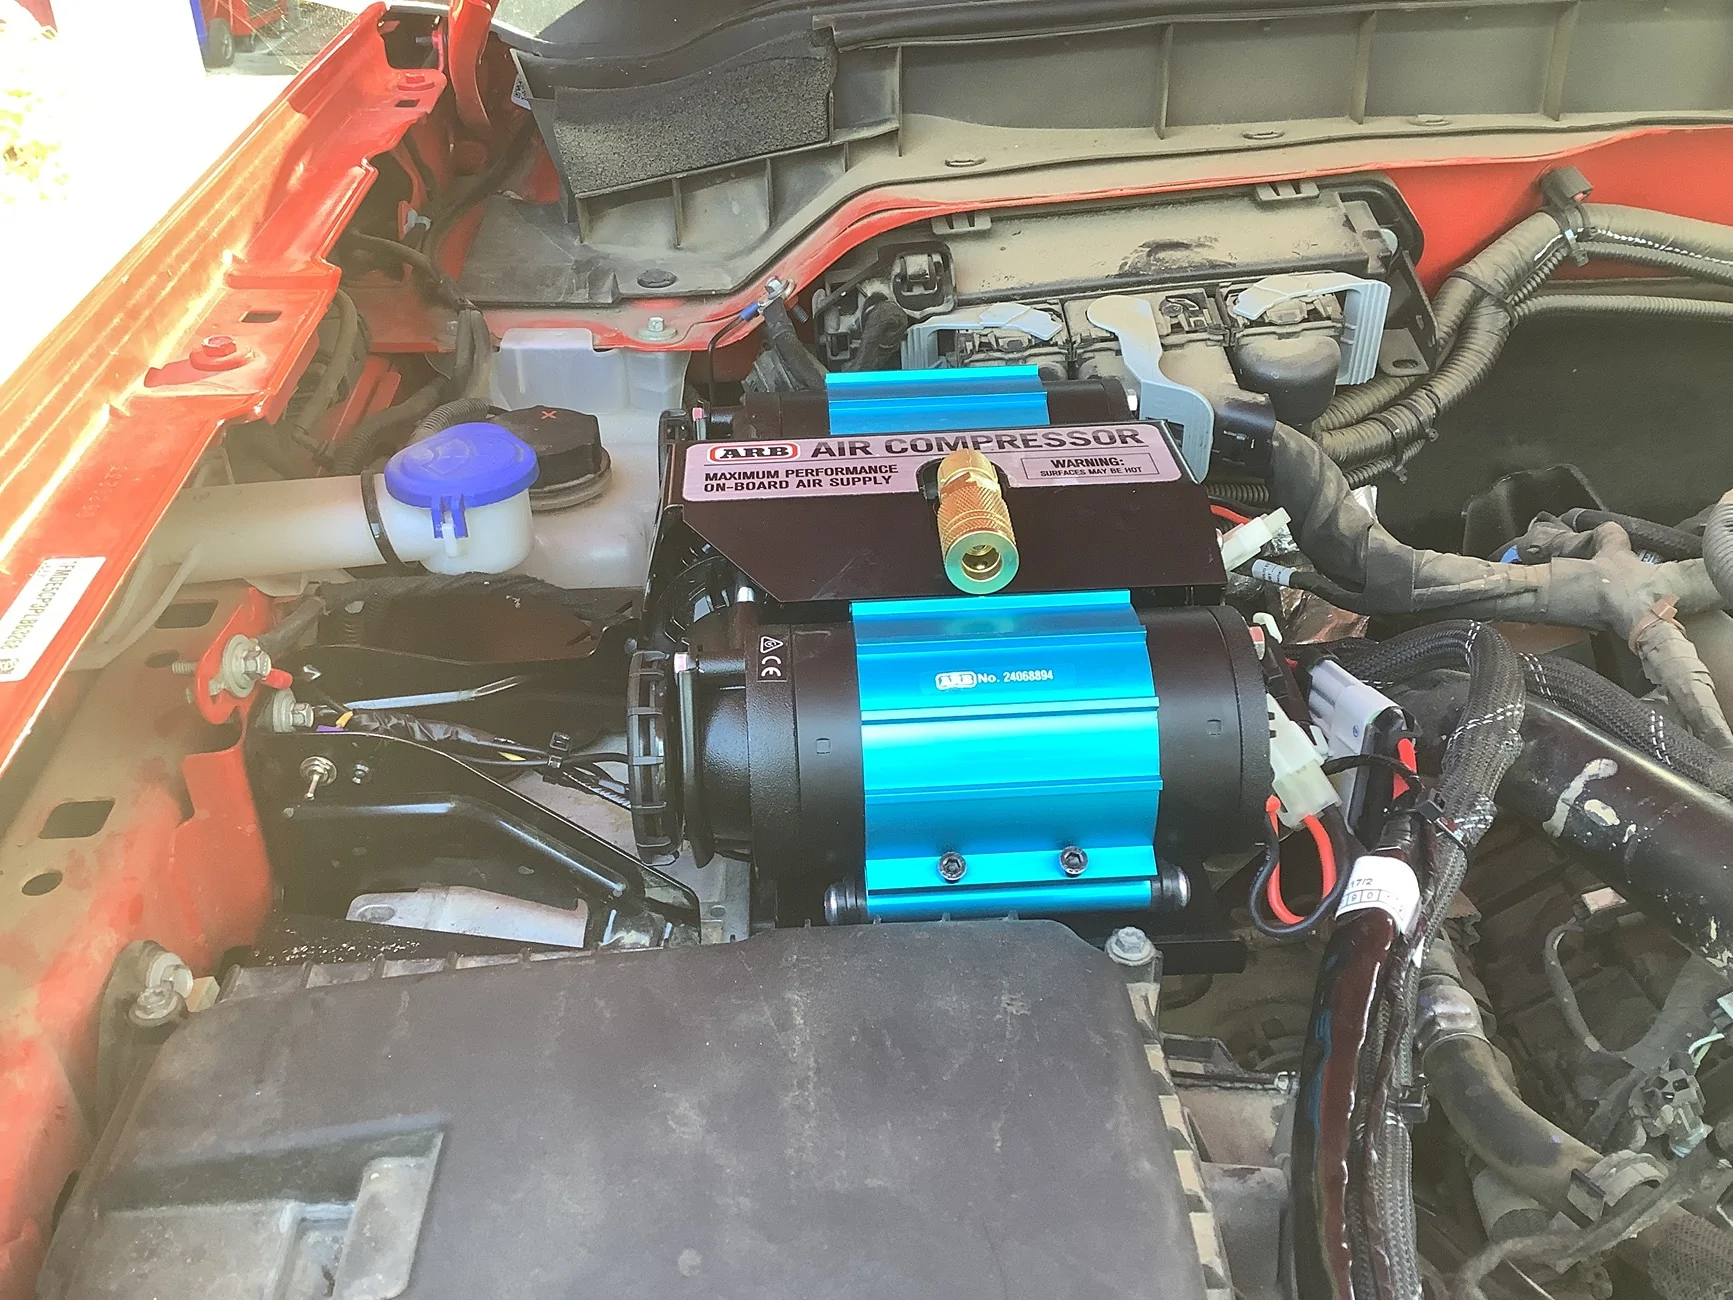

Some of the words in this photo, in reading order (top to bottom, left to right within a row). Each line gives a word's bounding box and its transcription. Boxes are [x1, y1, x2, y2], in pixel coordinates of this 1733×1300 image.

[811, 440, 873, 458] AIR
[885, 427, 1145, 454] COMPRESSOR
[719, 446, 790, 459] ARB
[1050, 456, 1126, 469] WARNING:
[704, 470, 780, 482] MAXIMUM
[785, 464, 899, 478] PERFORMANCE
[1110, 467, 1122, 475] BE
[1124, 466, 1143, 474] HOT
[704, 480, 790, 493] ON-BOARD
[795, 478, 823, 488] AIR
[829, 475, 893, 488] SUPPLY
[977, 673, 1000, 684] No.
[1002, 669, 1054, 683] 24068894
